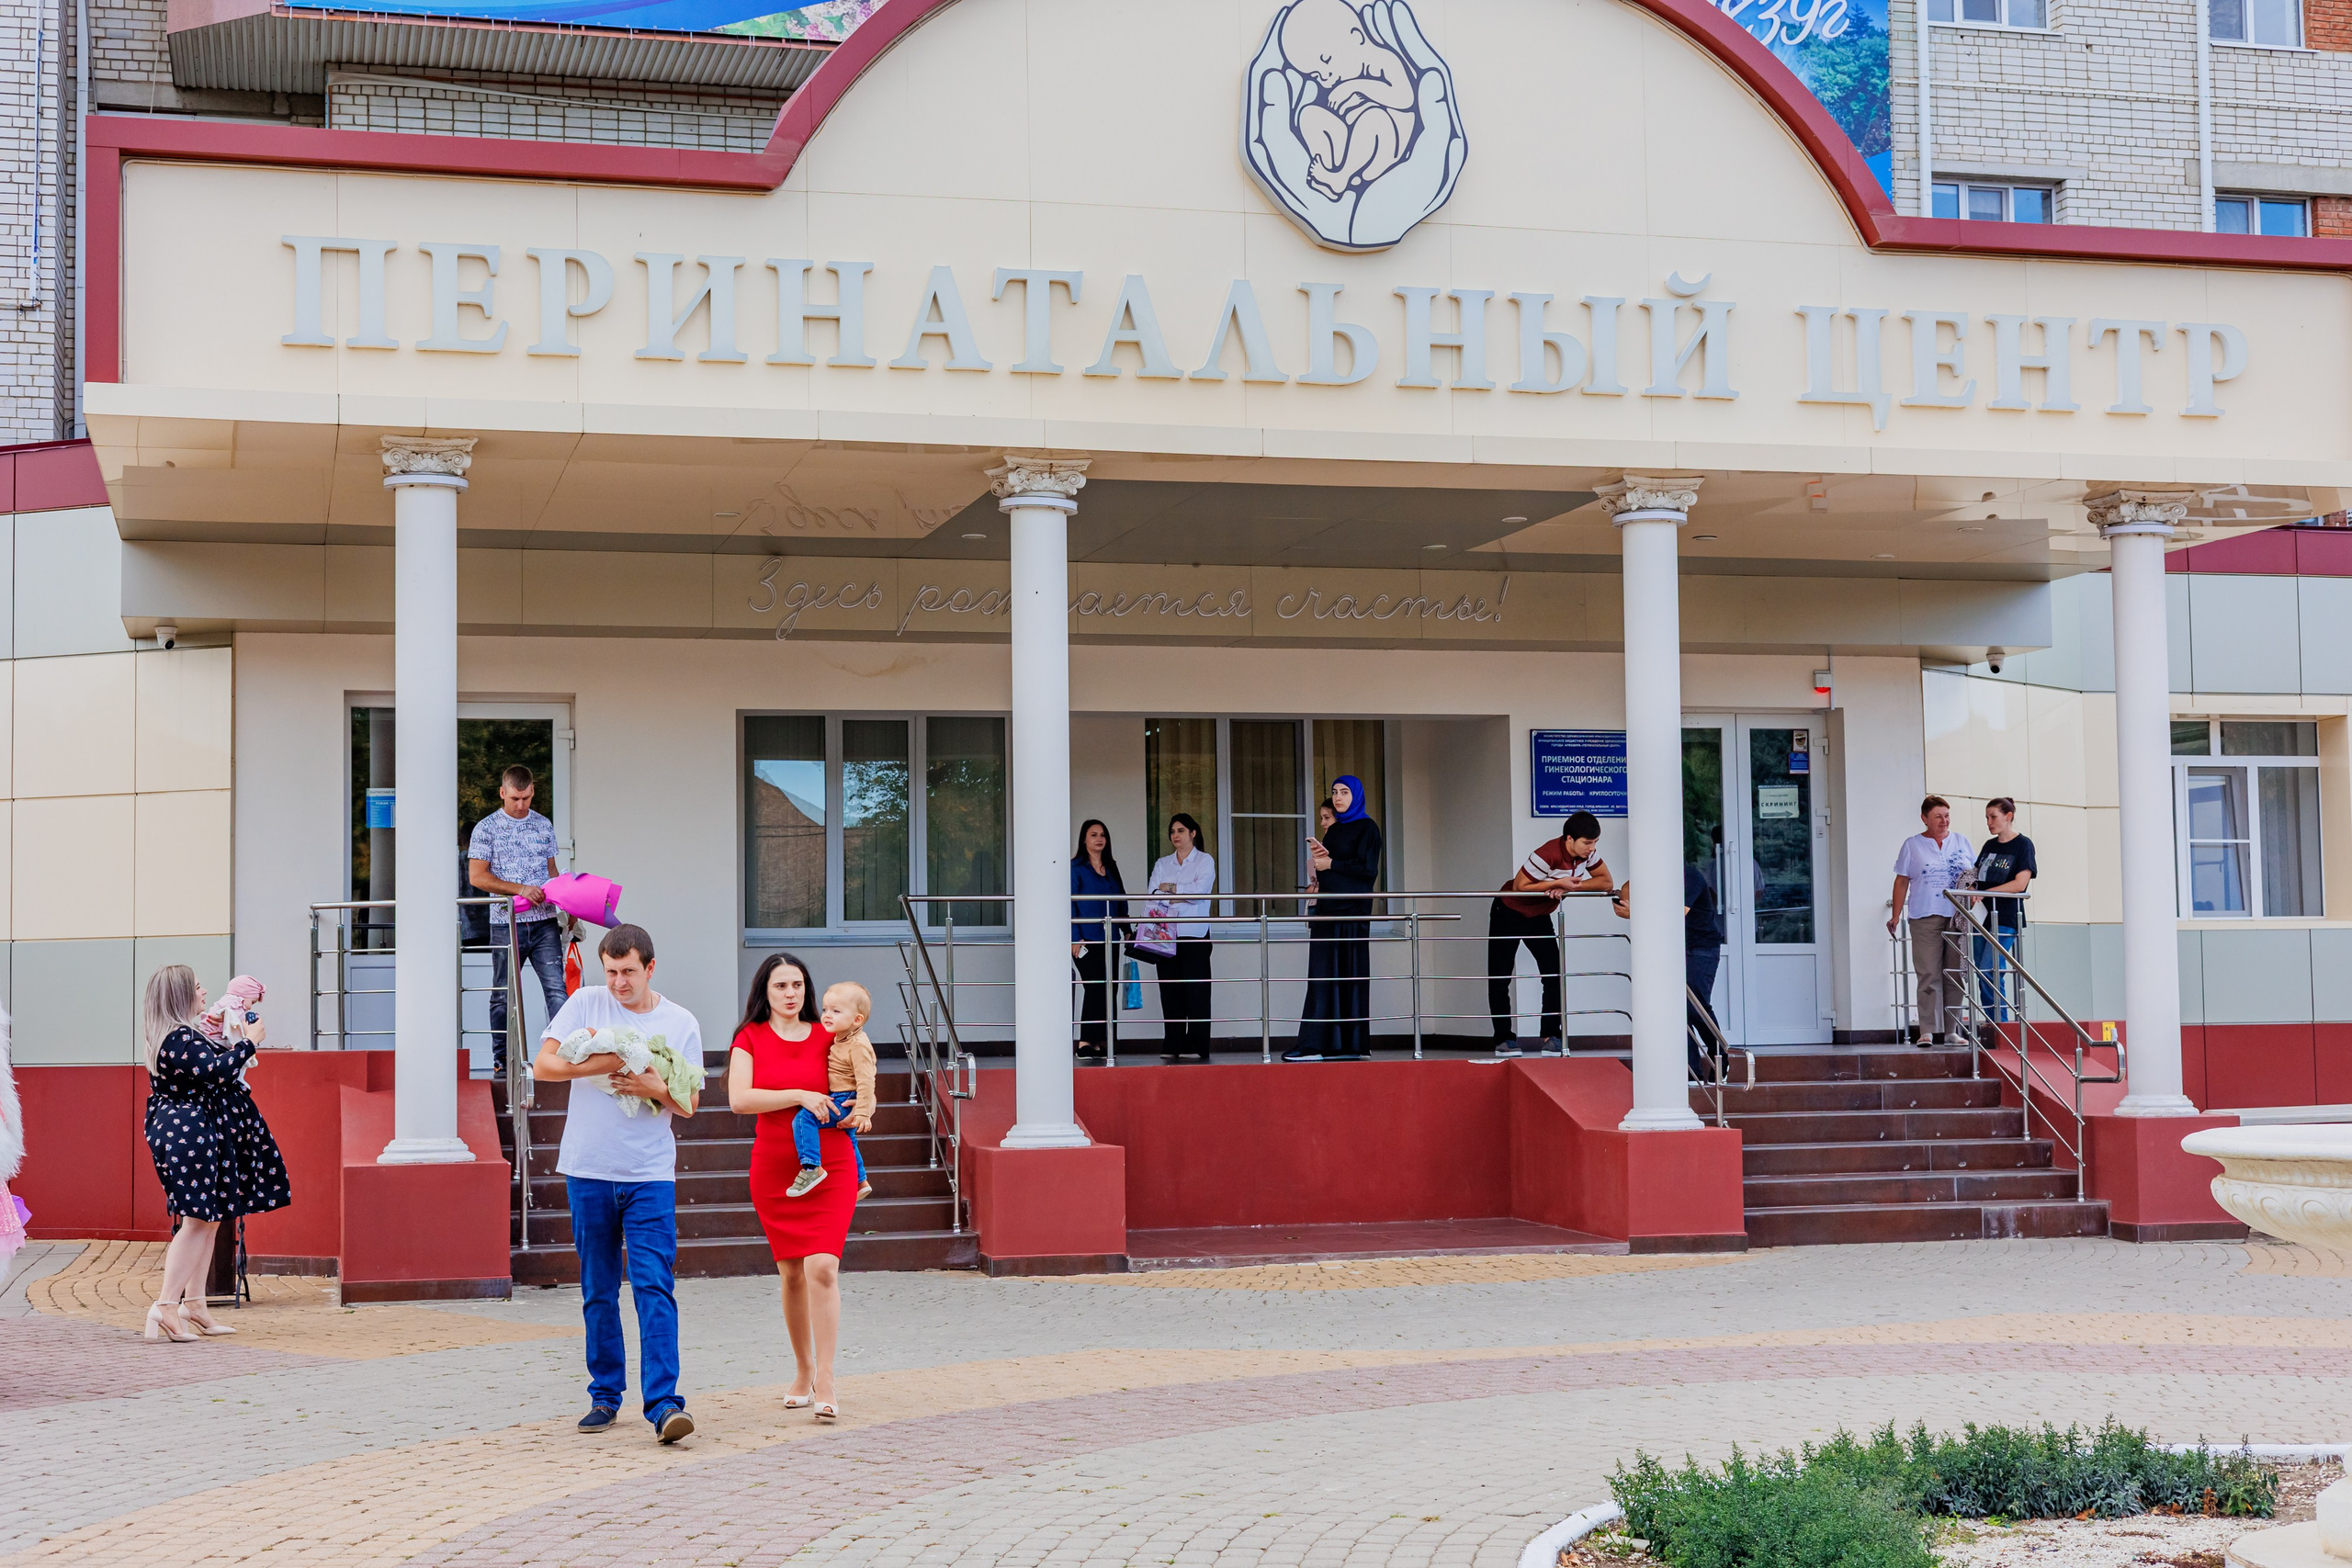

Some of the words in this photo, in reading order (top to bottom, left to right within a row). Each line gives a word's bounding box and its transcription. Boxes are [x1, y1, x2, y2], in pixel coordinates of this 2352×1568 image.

[281, 235, 1740, 400] ПЕРИНАТАЛЬНЫЙ
[1793, 305, 2248, 430] ЦЕНТР
[748, 556, 883, 640] Здесь
[1275, 575, 1510, 623] счастье!
[1542, 755, 1585, 763] ПРИЕМНОЕ
[1587, 756, 1627, 764] ОТДЕЛЕНИ
[1544, 765, 1627, 773] ГИНЕКОЛОГИЧЕСКОГО
[1561, 775, 1612, 784] СТАЦИОНАРА
